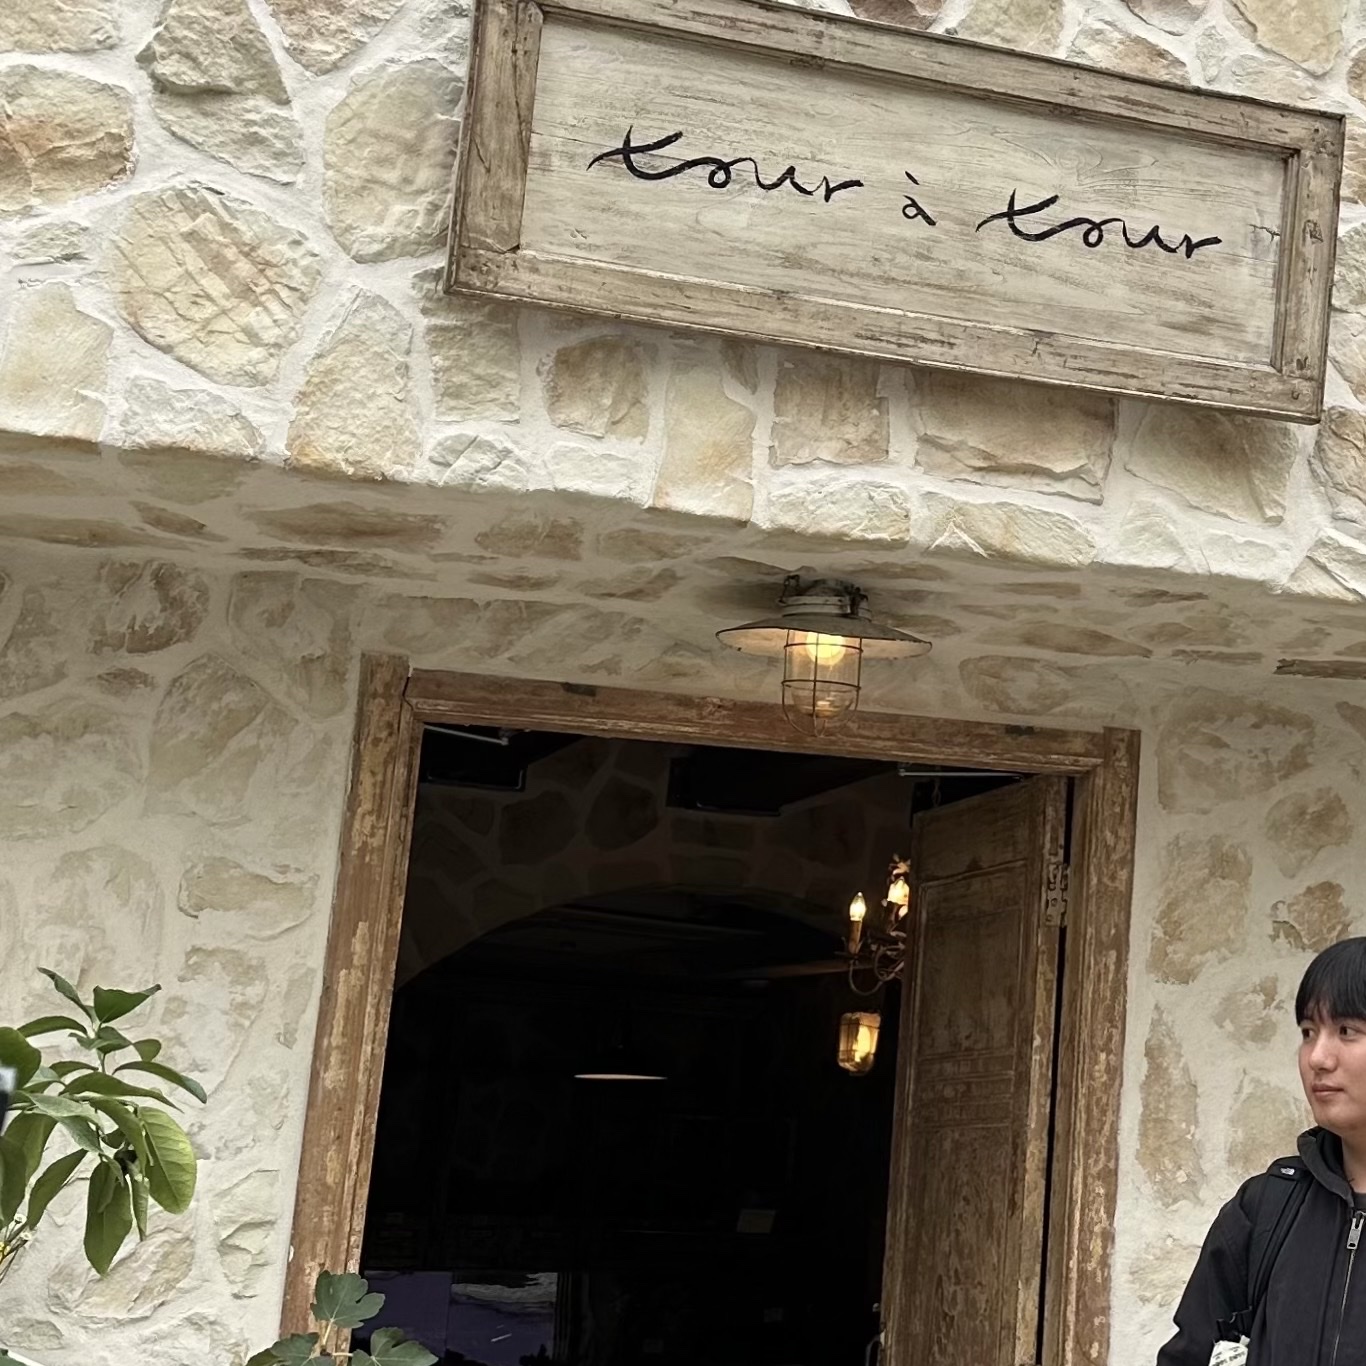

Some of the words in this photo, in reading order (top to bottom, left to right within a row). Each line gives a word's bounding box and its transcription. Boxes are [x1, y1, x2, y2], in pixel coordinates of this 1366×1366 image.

[588, 126, 865, 203] tour
[901, 171, 937, 227] à
[976, 189, 1223, 259] tour
